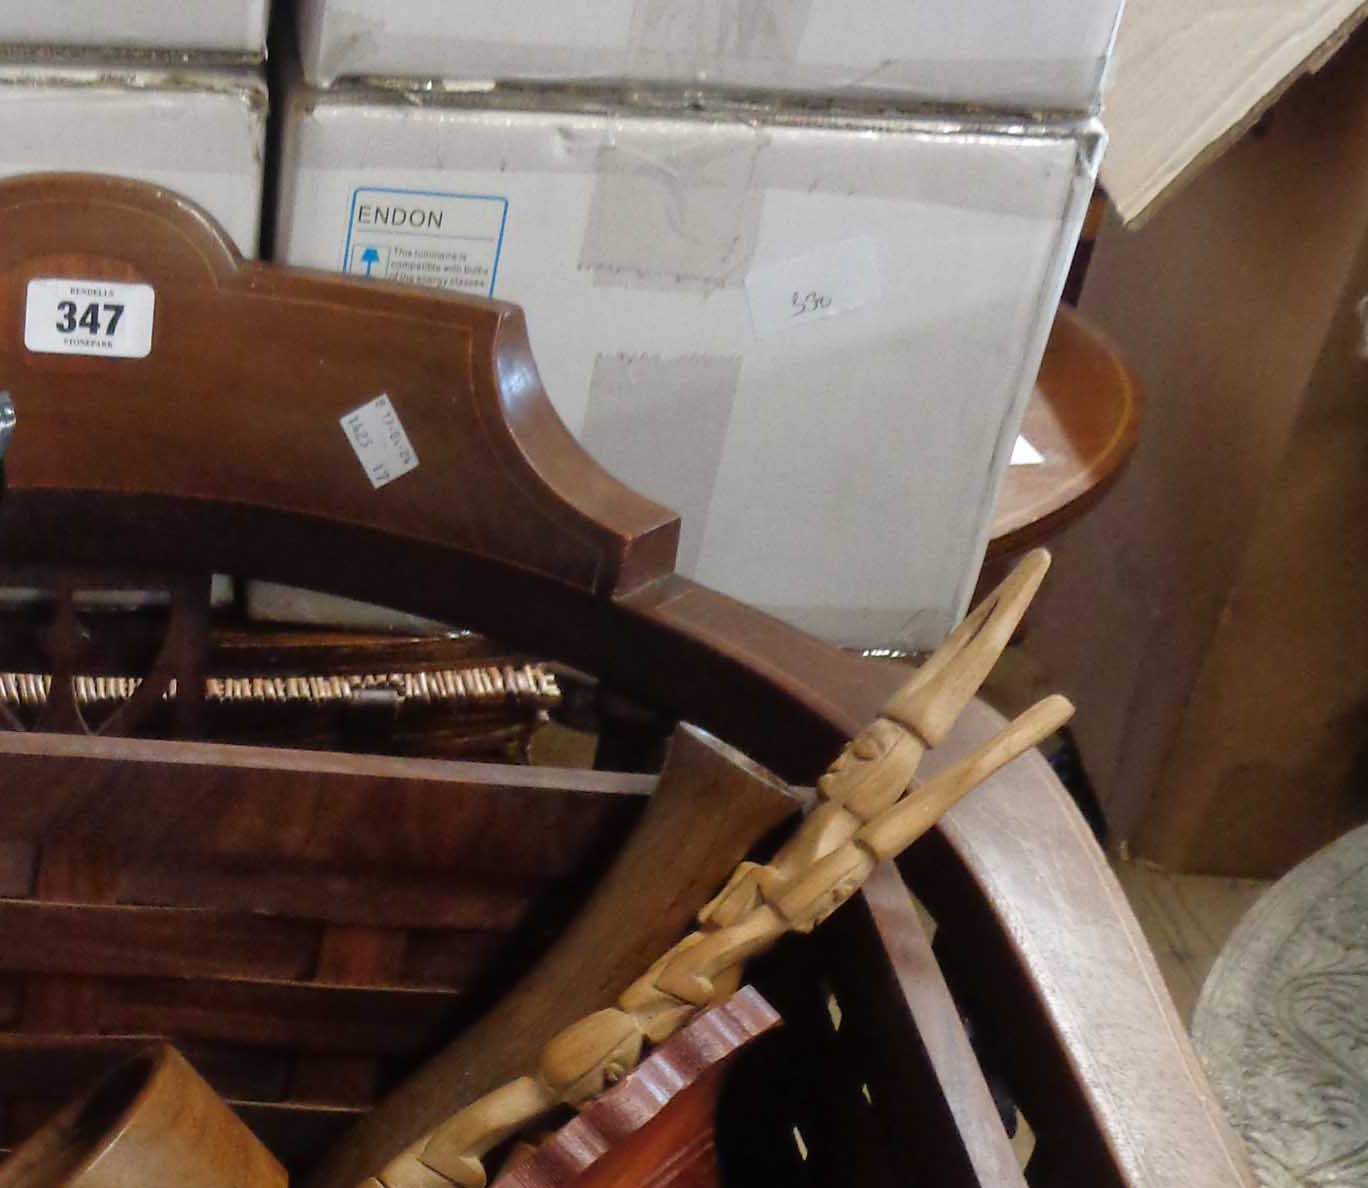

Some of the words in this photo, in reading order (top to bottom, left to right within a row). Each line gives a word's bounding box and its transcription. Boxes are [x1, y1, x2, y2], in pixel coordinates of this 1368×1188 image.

[358, 205, 443, 229] ENDON
[393, 246, 412, 257] This
[70, 287, 115, 298] RENDELLS
[56, 300, 125, 337] 347
[63, 337, 113, 349] STONEPARK
